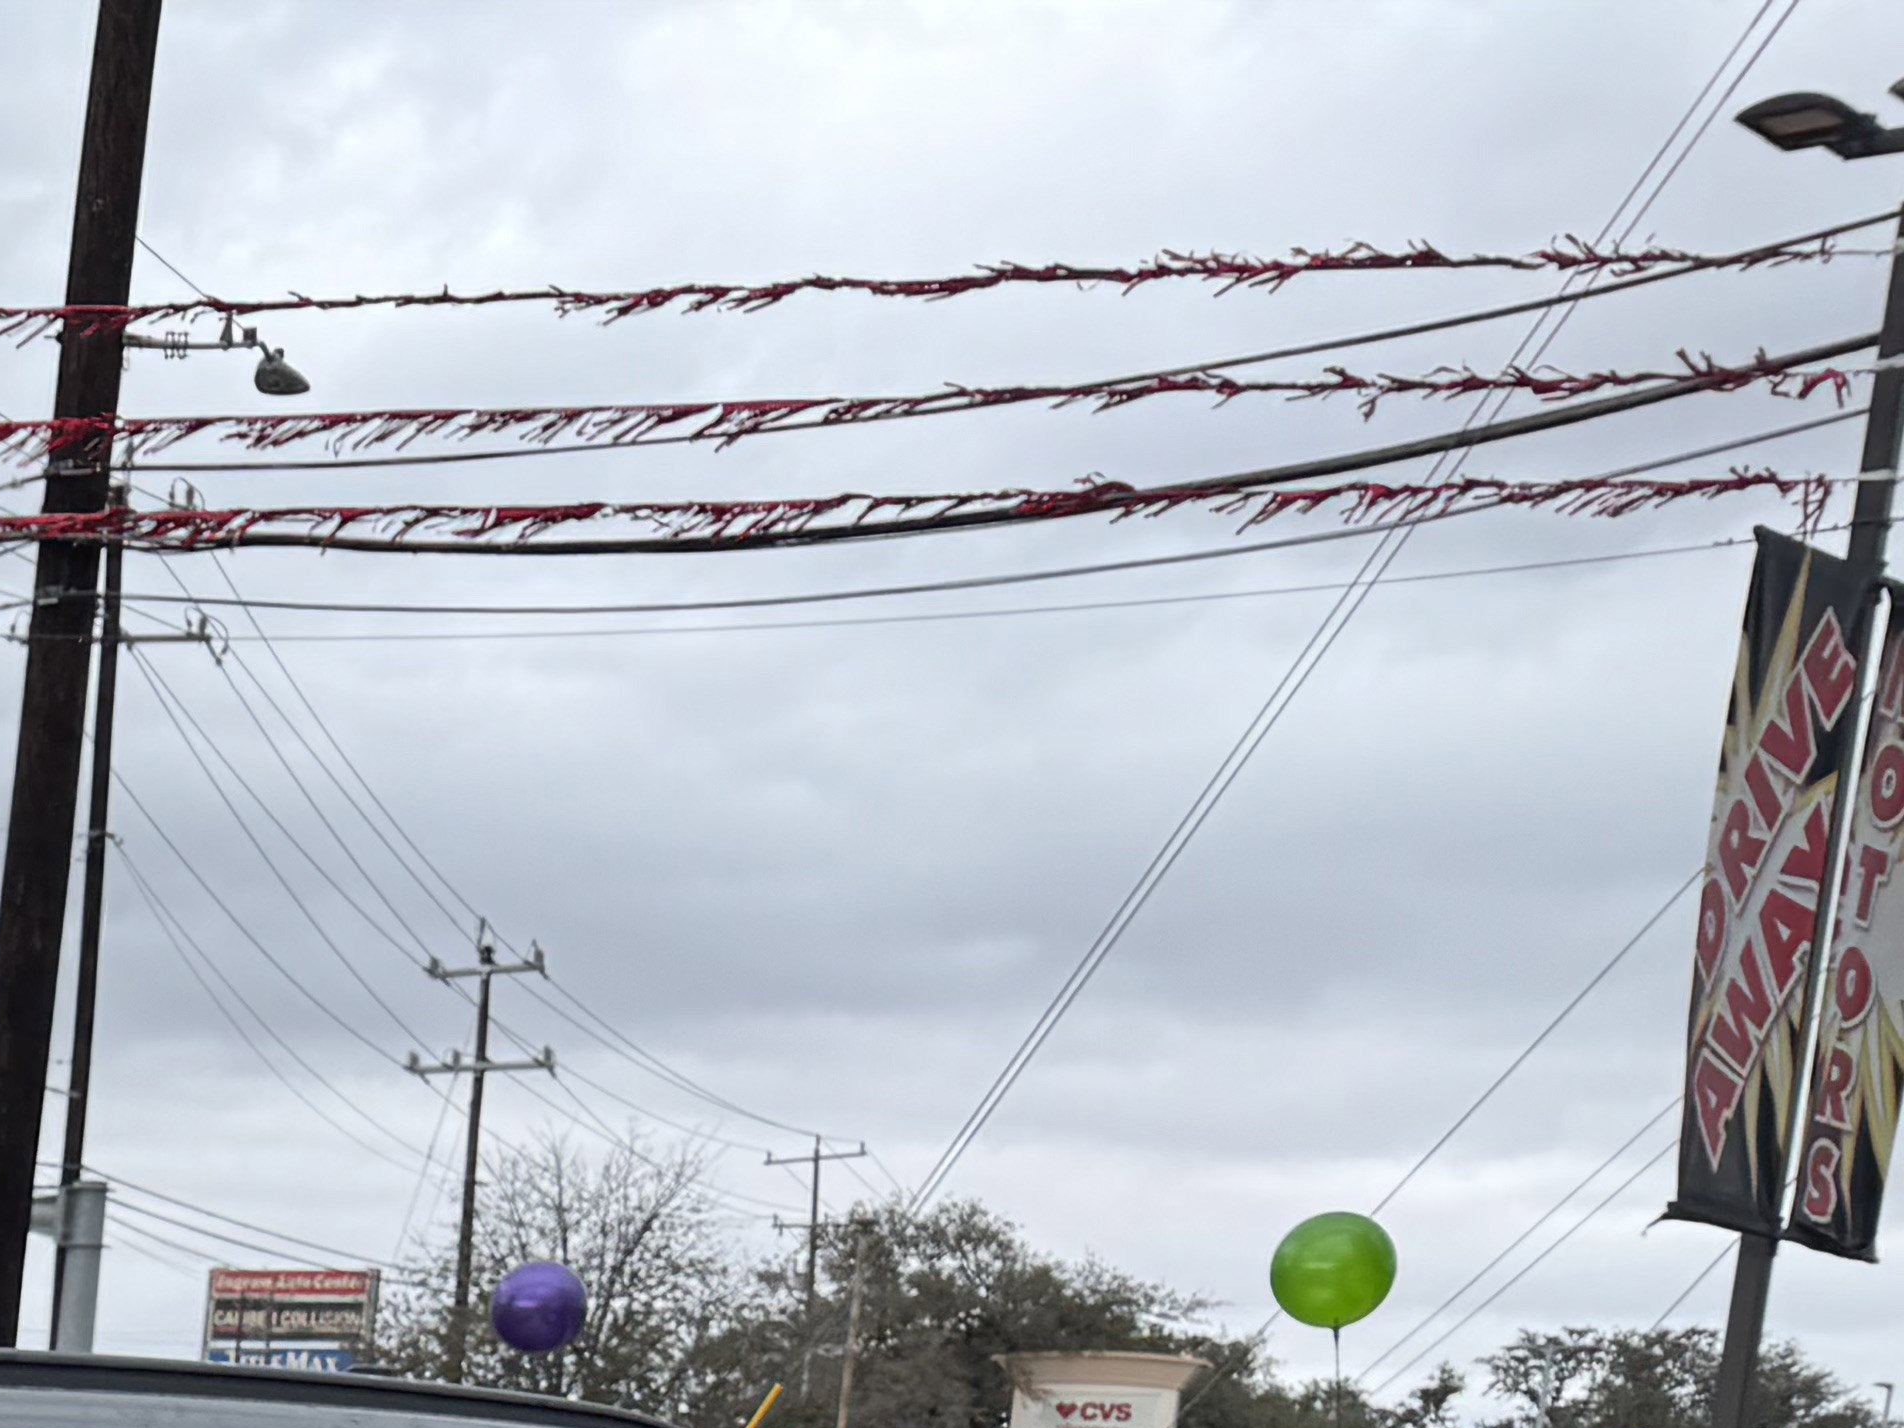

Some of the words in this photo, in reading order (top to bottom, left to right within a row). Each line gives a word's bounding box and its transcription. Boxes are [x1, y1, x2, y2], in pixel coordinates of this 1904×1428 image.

[1694, 796, 1832, 1174] AWAY
[1695, 605, 1857, 994] DRIVE
[1080, 1402, 1132, 1422] CVS
